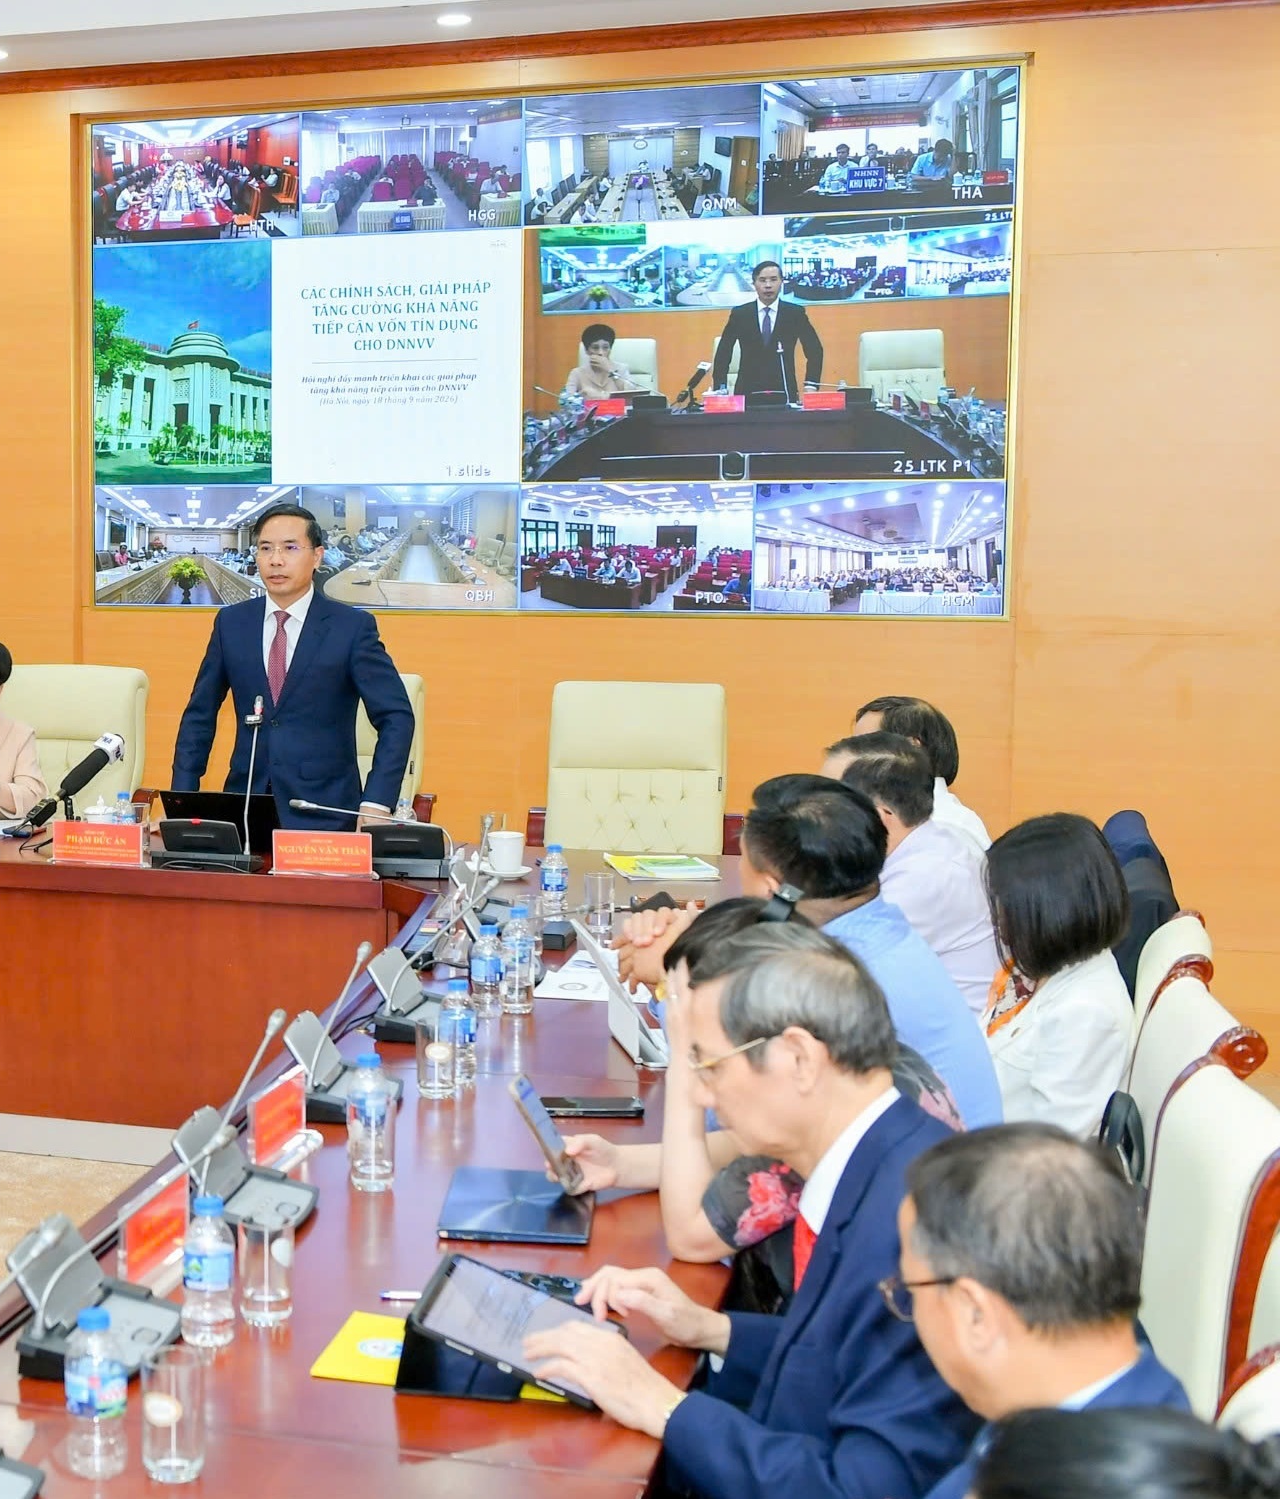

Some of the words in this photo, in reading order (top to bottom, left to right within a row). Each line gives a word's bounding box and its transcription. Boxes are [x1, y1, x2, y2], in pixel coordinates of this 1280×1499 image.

[853, 169, 880, 177] NHNN
[849, 179, 863, 189] KHU
[878, 178, 883, 187] 7
[951, 186, 983, 200] THA
[468, 208, 496, 222] HGG
[249, 219, 274, 232] HTH
[330, 283, 372, 298] CHÍNH
[377, 283, 415, 297] SÁCH,
[312, 303, 348, 317] TĂNG
[351, 300, 402, 315] CƯỜNG
[440, 298, 478, 313] NĂNG
[312, 319, 343, 335] TIẾP
[347, 319, 374, 336] CẬN
[378, 317, 406, 333] VỐN
[410, 317, 434, 332] TÍN
[439, 318, 478, 334] DỤNG
[354, 339, 382, 351] CHO
[387, 337, 435, 350] DNNVV
[893, 459, 914, 473] 25
[920, 459, 947, 472] LTK
[953, 459, 971, 472] P1
[942, 592, 976, 607] HCM
[66, 834, 92, 845] PHẠM
[278, 844, 317, 854] NGUYỄN
